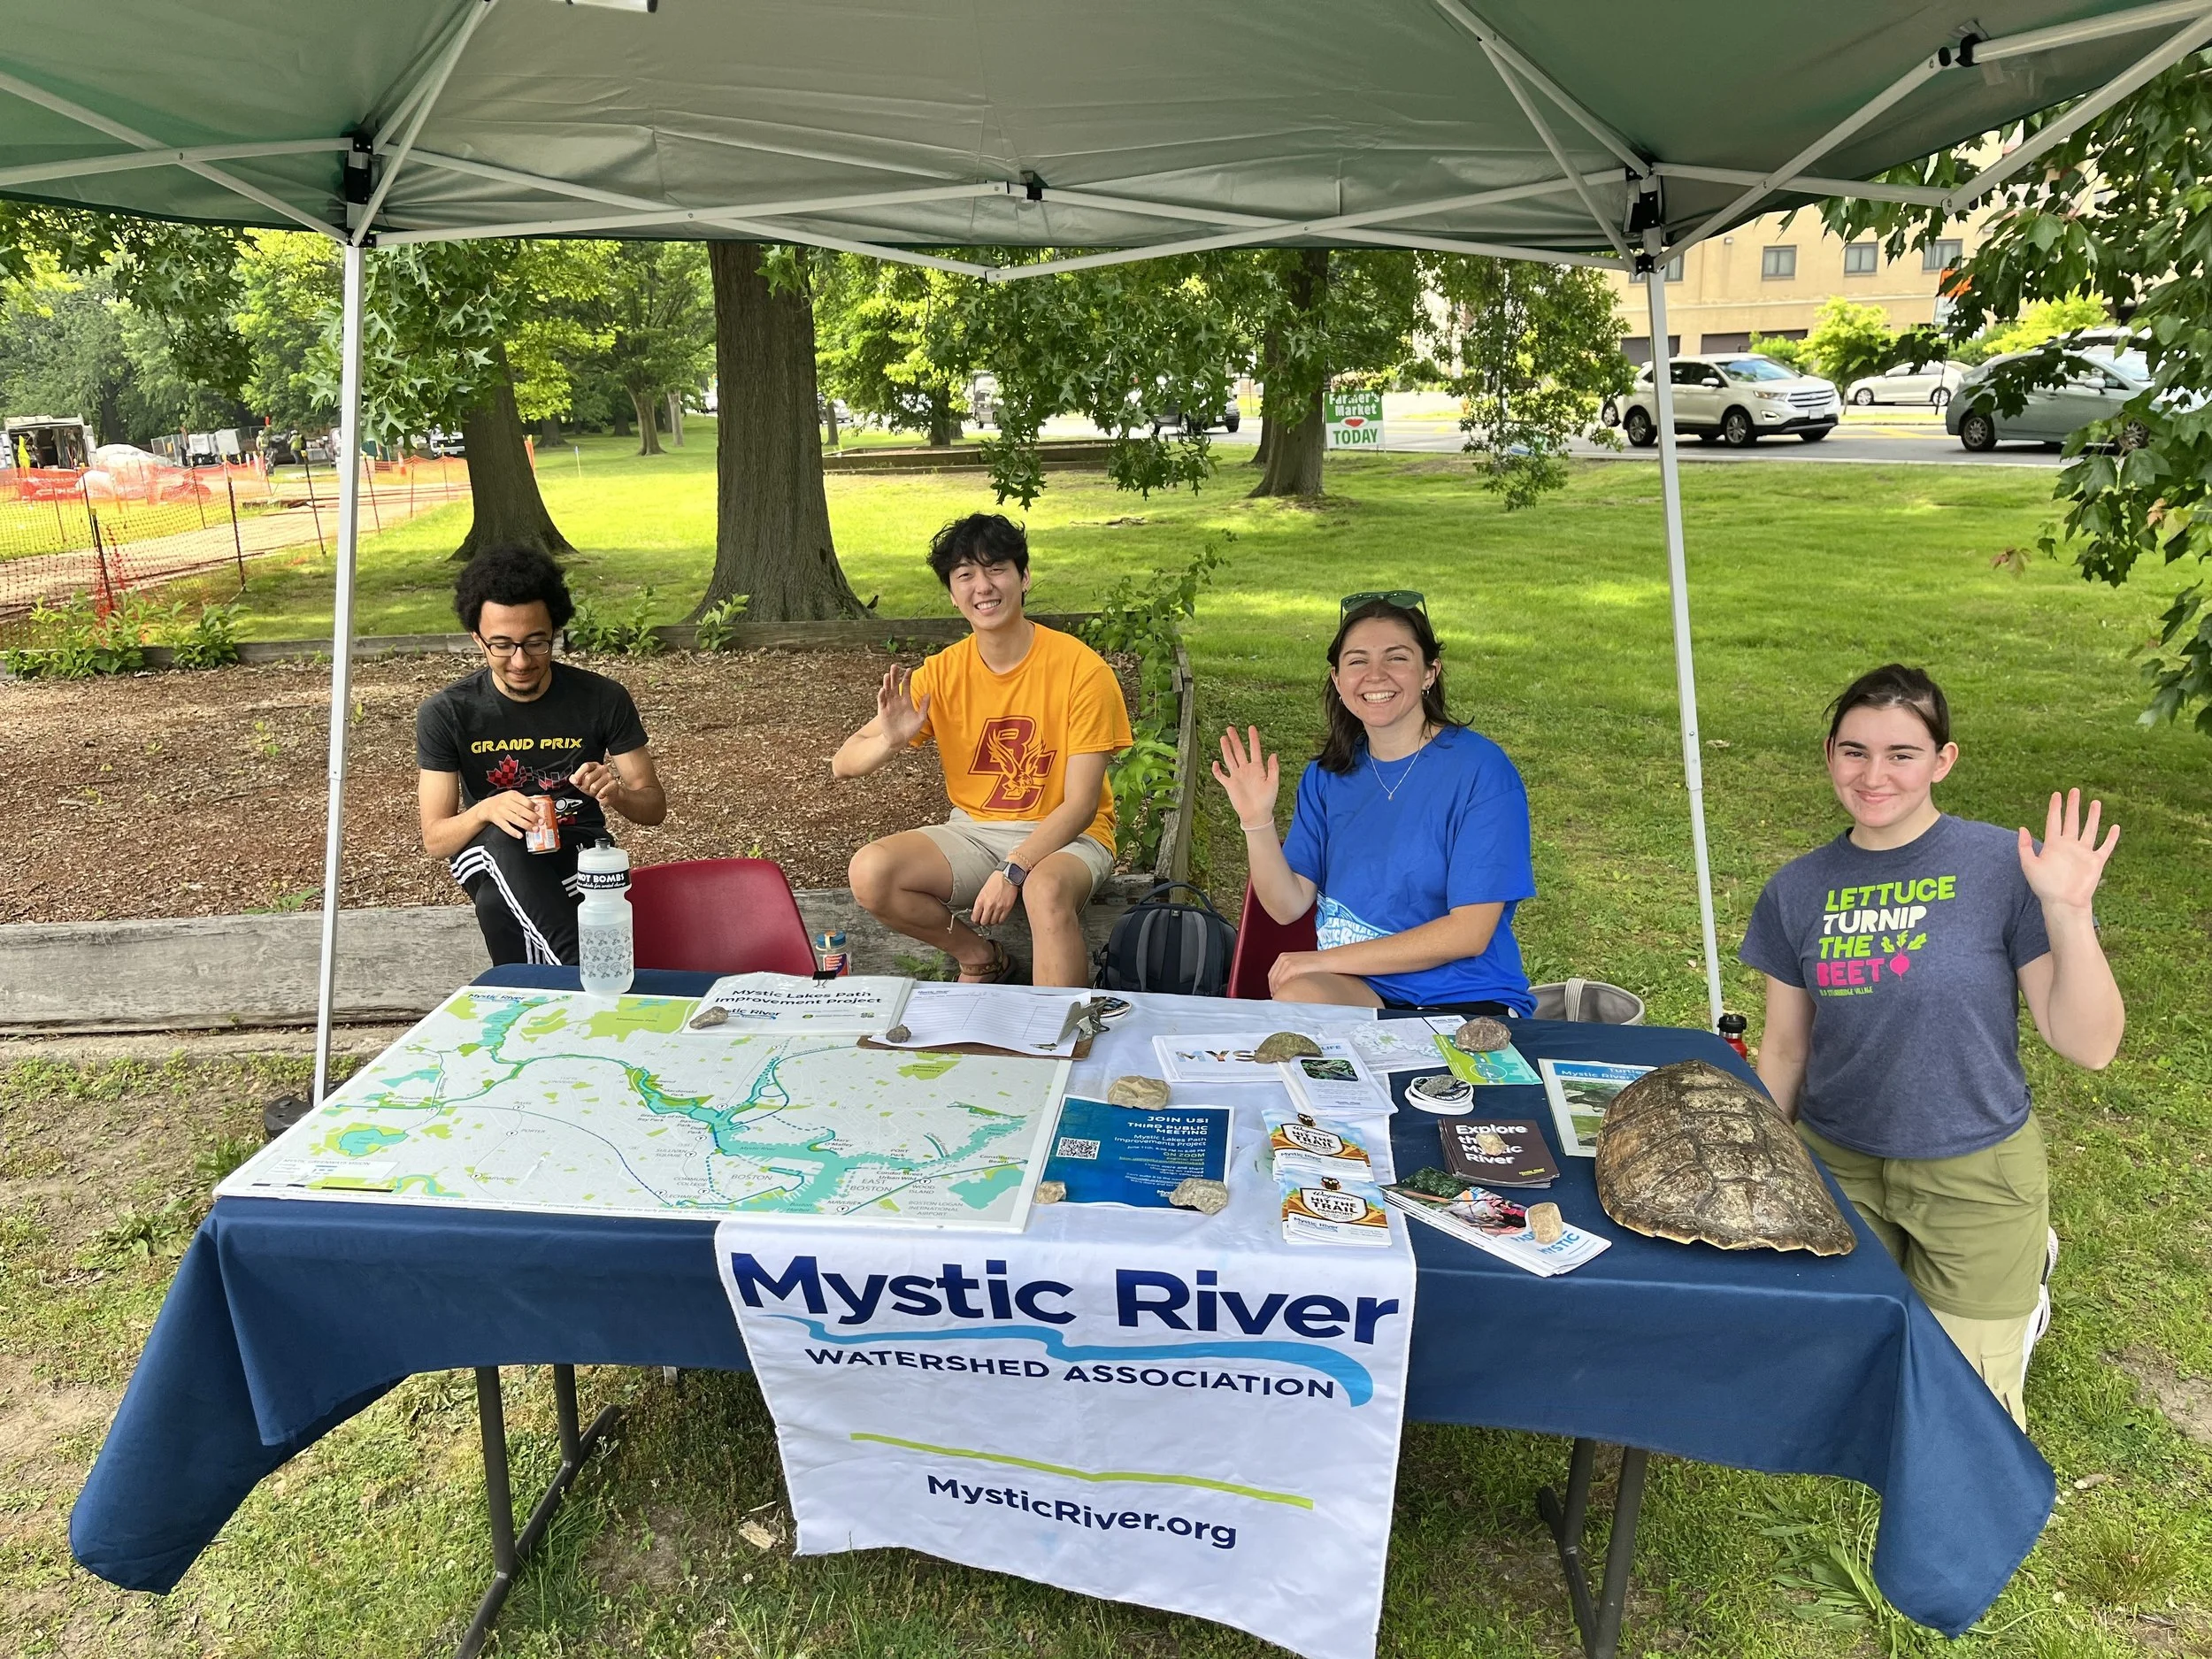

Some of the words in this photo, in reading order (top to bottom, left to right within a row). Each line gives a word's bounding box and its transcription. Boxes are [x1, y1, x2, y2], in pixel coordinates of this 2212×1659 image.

[1328, 392, 1379, 405] Farmer's
[1334, 403, 1377, 417] Market
[1333, 428, 1378, 444] TODAY
[471, 738, 534, 754] GRAND
[540, 737, 583, 750] PRIX
[593, 873, 625, 883] BOMBS
[1824, 874, 1957, 912] LETTUCE
[1823, 905, 1927, 935] TURNIP
[1818, 935, 1874, 959] THE
[1816, 957, 1886, 987] BEET
[732, 989, 781, 998] Mystic
[1855, 987, 1874, 995] VILLAGE
[1293, 1126, 1329, 1137] Wegmans
[1455, 1124, 1528, 1134] Explore
[1114, 1137, 1175, 1147] Improvements
[1294, 1134, 1336, 1148] TRAIL
[1457, 1135, 1479, 1144] th
[1462, 1144, 1524, 1155] Myic
[1465, 1153, 1515, 1164] River
[1312, 1191, 1353, 1201] Wegmans
[1311, 1202, 1358, 1213] TRAIL
[1537, 1233, 1580, 1255] MYSTIC
[729, 1251, 1074, 1325] Mystic
[1114, 1269, 1400, 1346] River
[803, 1348, 1051, 1379] WATERSHED
[1062, 1363, 1335, 1401] ASSOCIATION
[926, 1474, 1239, 1550] MysticRiver.org
